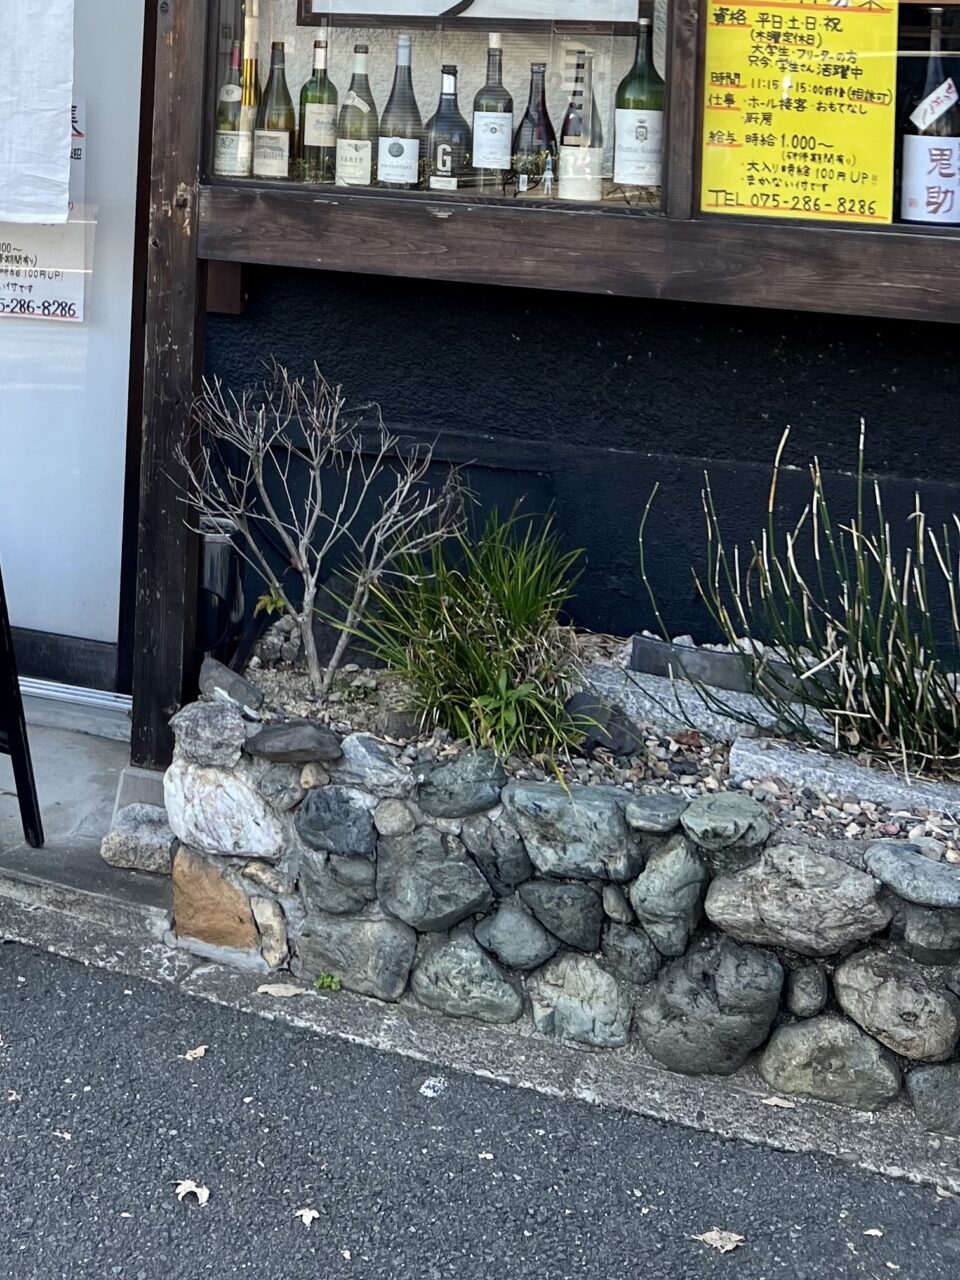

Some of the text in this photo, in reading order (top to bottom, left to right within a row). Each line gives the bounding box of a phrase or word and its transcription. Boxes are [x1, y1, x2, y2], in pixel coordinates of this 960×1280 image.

[712, 7, 747, 25] 資格
[711, 72, 740, 86] 時間
[709, 94, 736, 108] 仕事
[709, 130, 737, 145] 給与
[436, 143, 452, 172] G
[708, 189, 877, 215] TEL 075-286-8286
